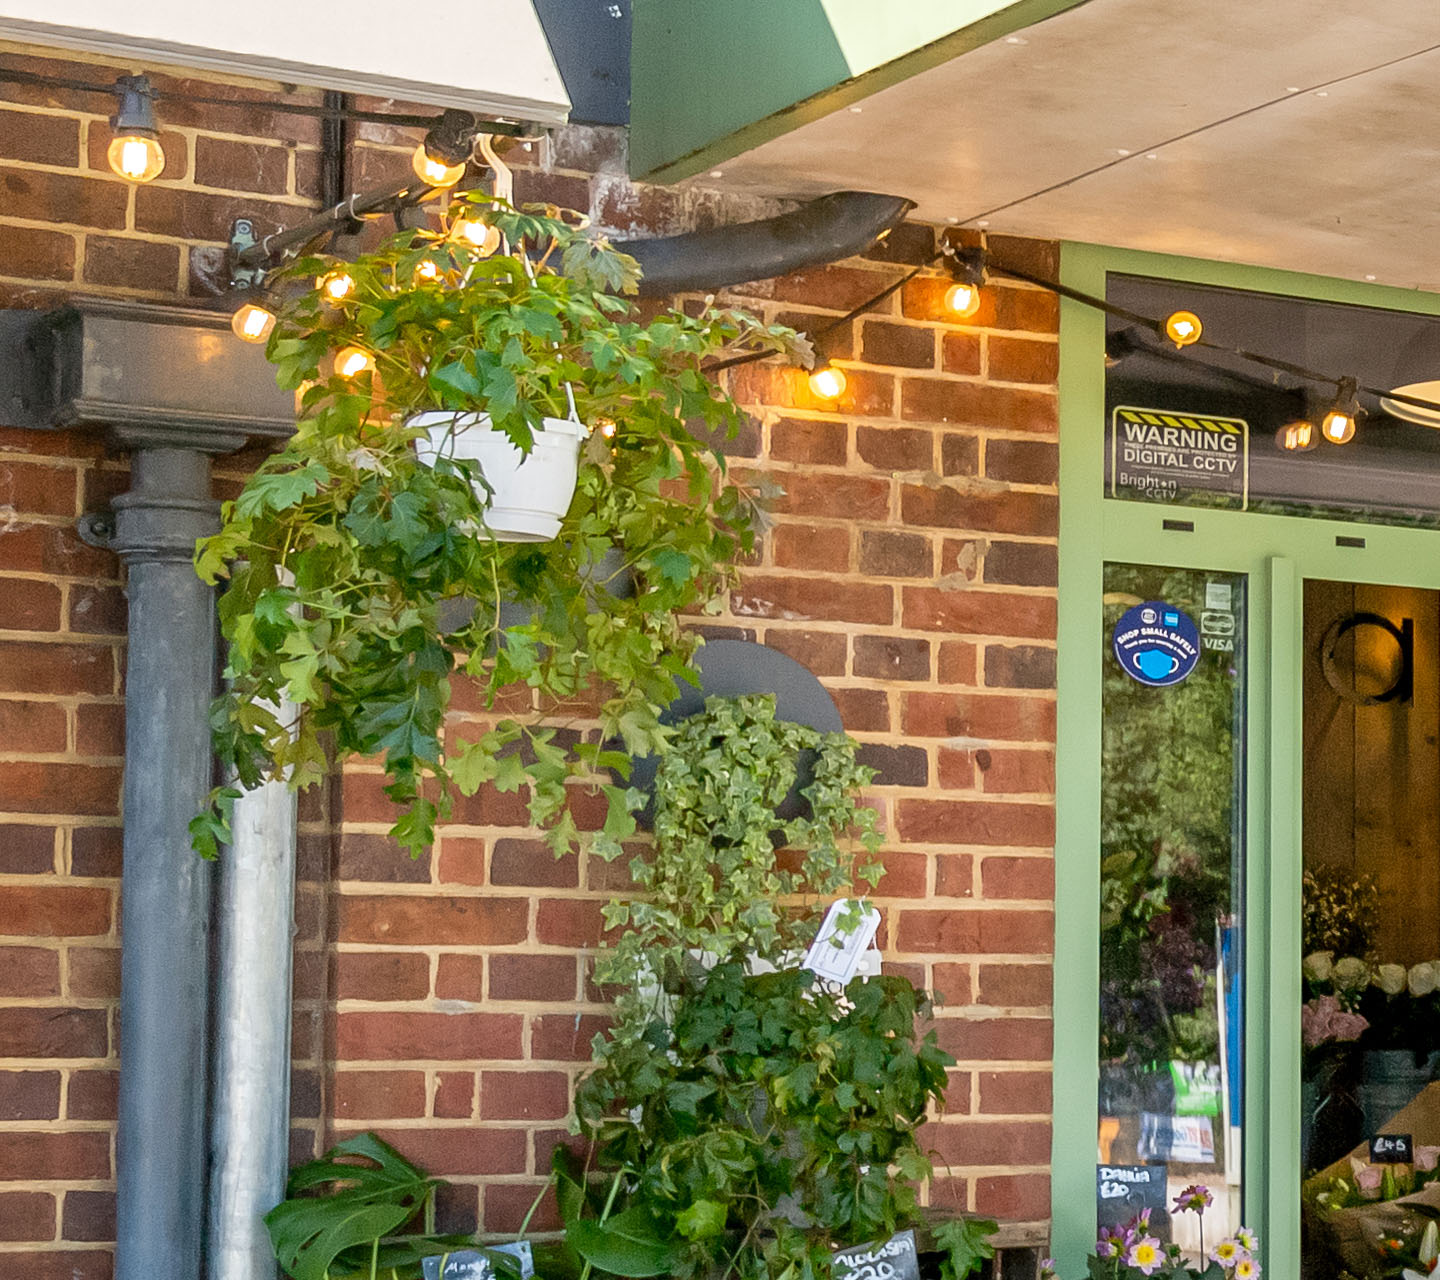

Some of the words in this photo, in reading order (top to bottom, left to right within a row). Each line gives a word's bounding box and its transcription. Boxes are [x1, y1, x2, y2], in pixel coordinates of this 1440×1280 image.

[1124, 423, 1237, 452] WARNING
[1124, 448, 1189, 468] DIGITAL
[1193, 456, 1237, 473] CCTV
[1146, 488, 1177, 499] CCTV
[1117, 629, 1140, 645] SHOP
[1141, 627, 1168, 639] SMALL
[1203, 637, 1234, 652] VISA
[1100, 1181, 1130, 1199] £20
